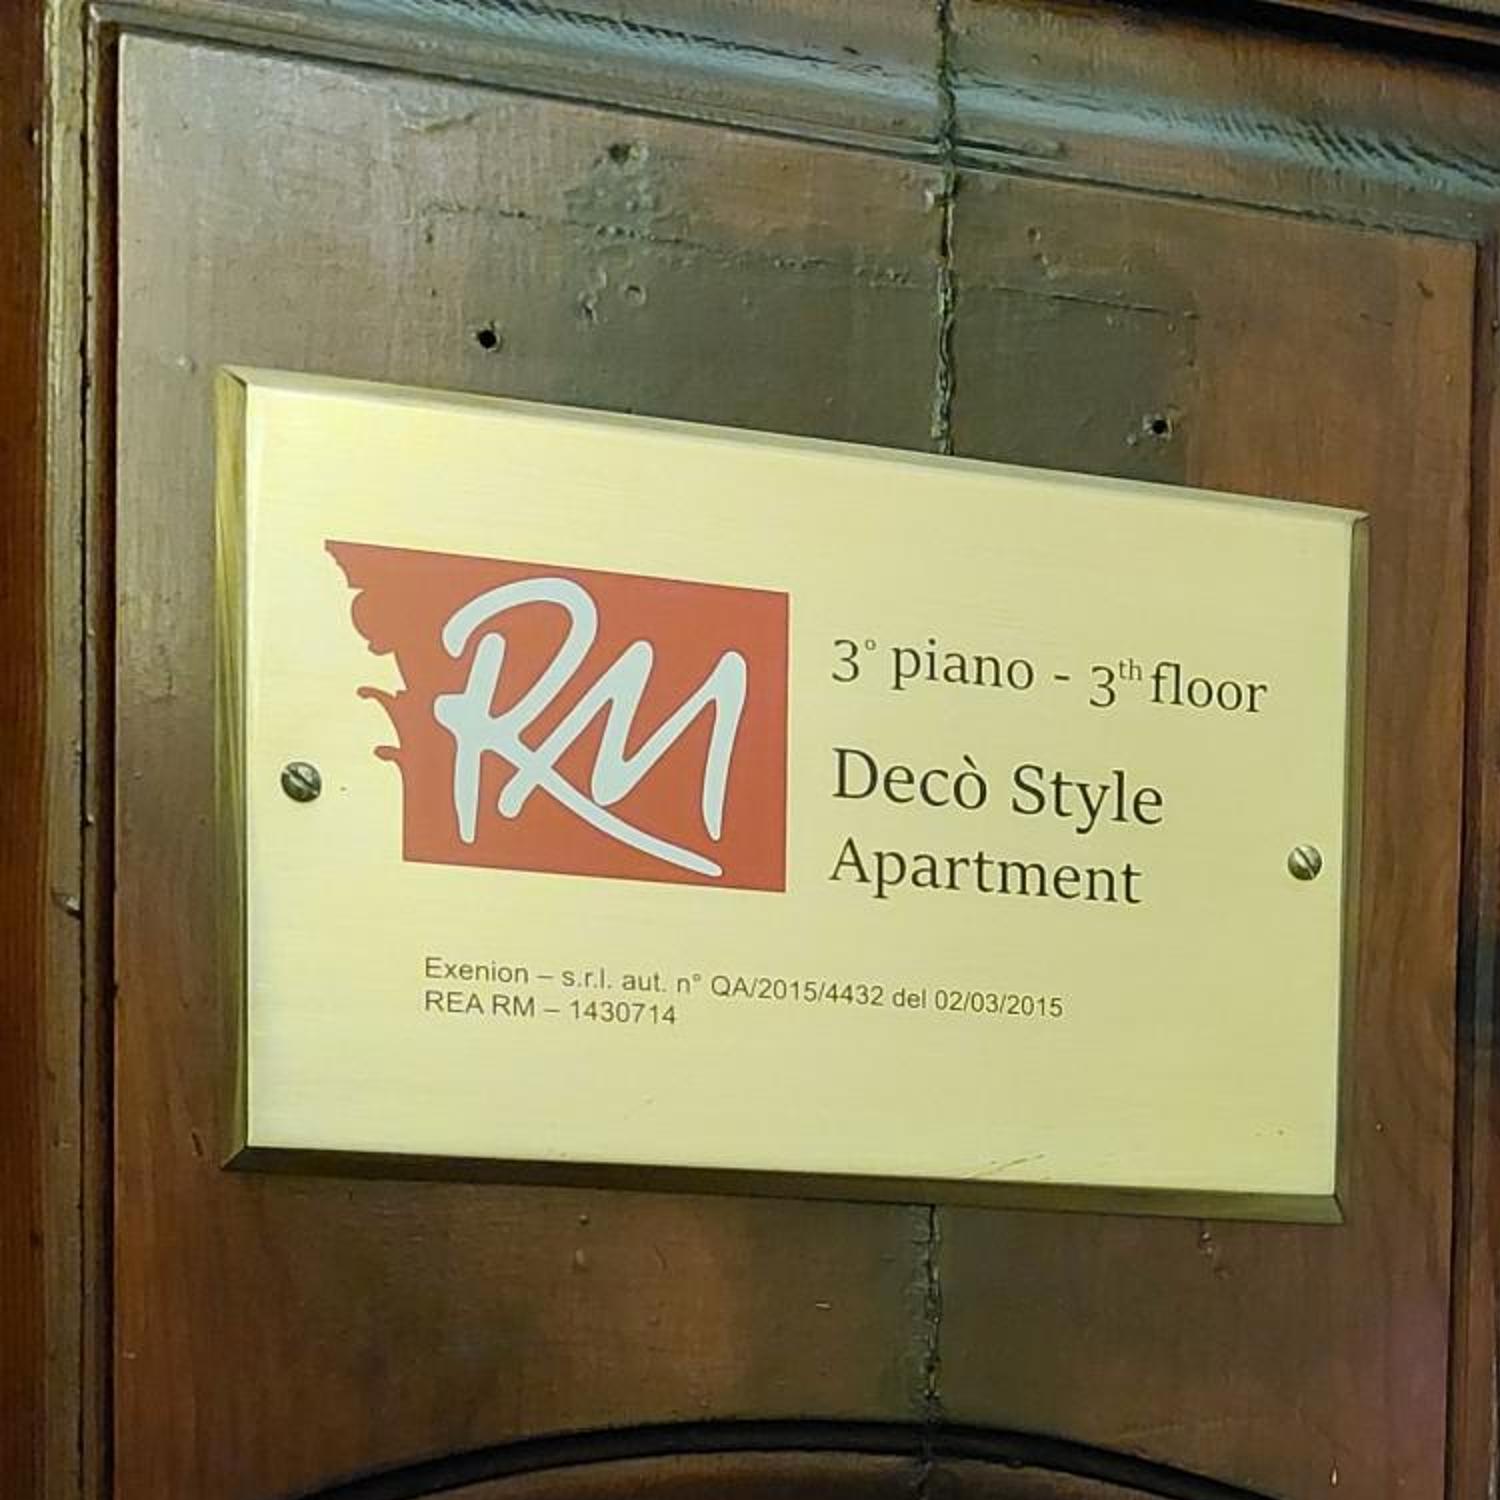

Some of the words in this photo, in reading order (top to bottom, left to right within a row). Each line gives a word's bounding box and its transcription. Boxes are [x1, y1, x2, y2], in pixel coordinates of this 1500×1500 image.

[891, 637, 1034, 691] piano
[1089, 657, 1143, 708] 3th
[1150, 661, 1268, 713] floor
[434, 576, 750, 878] RM
[832, 747, 988, 811] Decò
[1011, 763, 1164, 835] Style
[828, 836, 1142, 905] Apartment
[425, 956, 529, 984] Exenion
[561, 967, 612, 989] s.r.l.
[621, 973, 667, 993] aut.
[711, 975, 884, 1007] QA/2015/4432
[892, 987, 927, 1009] del
[934, 989, 1063, 1018] 02/03/2015
[425, 989, 485, 1015] REA
[492, 993, 535, 1018] RM
[570, 999, 676, 1026] 1430714
